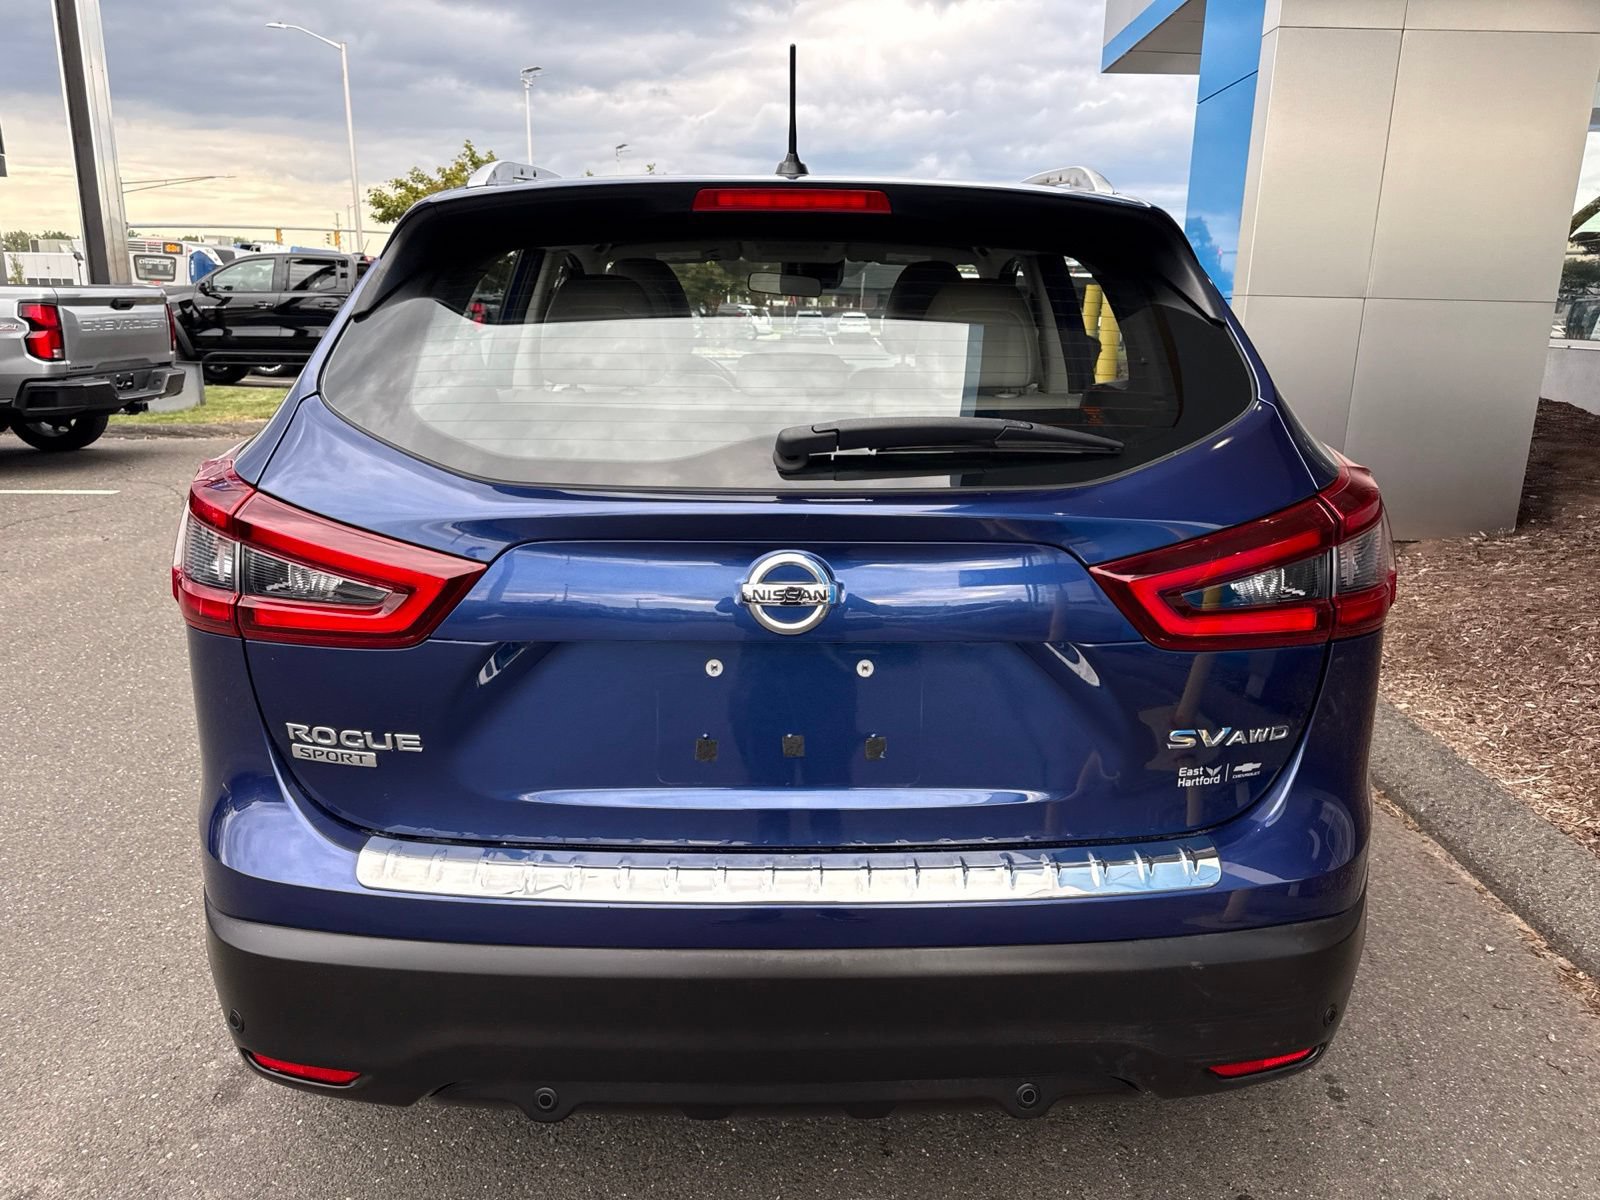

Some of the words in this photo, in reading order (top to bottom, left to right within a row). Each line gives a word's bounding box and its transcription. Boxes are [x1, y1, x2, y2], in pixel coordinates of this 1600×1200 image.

[80, 319, 165, 332] CHEVROLET
[752, 589, 827, 602] NISSAN
[285, 722, 423, 752] ROGUE
[1226, 726, 1289, 746] AWD
[300, 748, 367, 764] SPORT
[1178, 767, 1203, 776] East
[1177, 775, 1220, 787] Hartford
